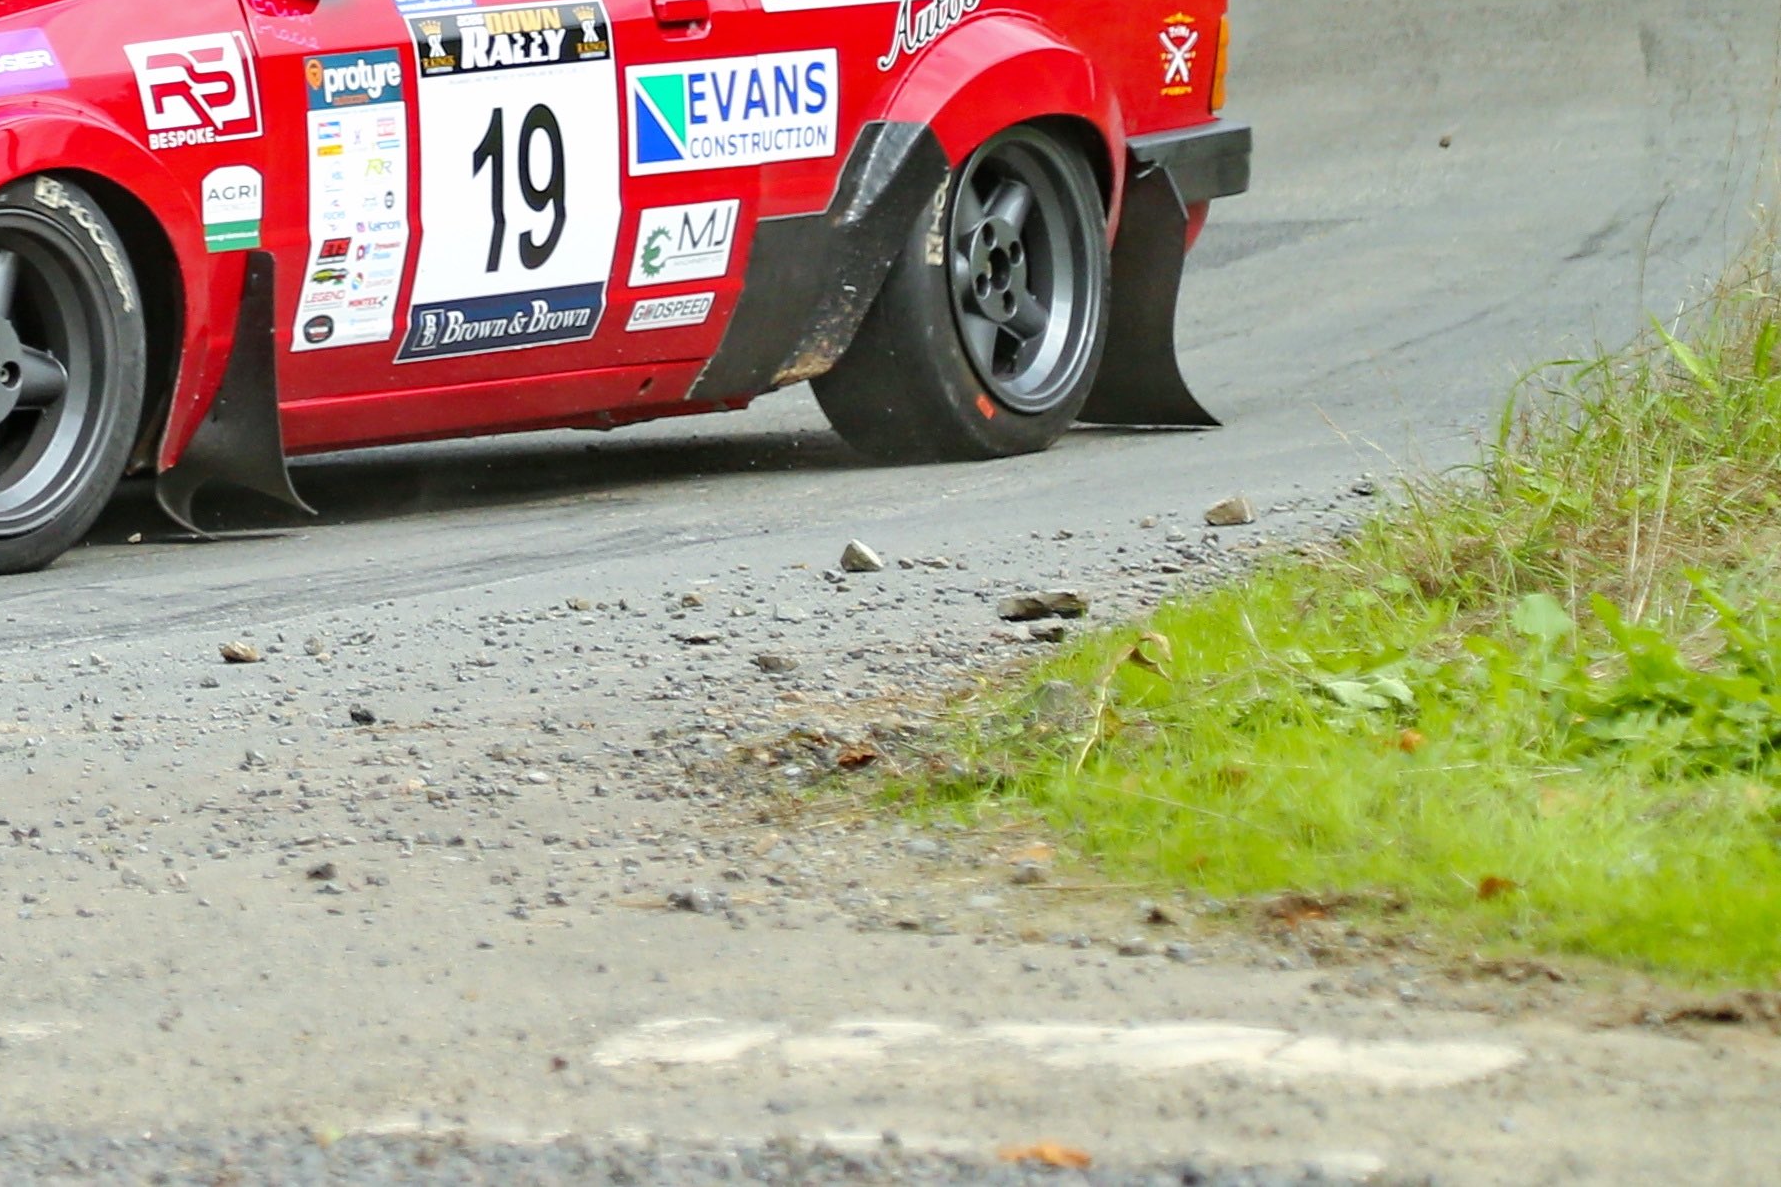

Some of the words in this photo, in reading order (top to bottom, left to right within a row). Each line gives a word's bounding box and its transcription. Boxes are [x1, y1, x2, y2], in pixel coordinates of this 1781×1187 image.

[483, 8, 561, 35] DOWN
[460, 25, 566, 70] RALLY
[323, 59, 401, 103] protyre
[688, 61, 828, 125] EVANS
[148, 126, 215, 150] BESPOKE
[690, 125, 828, 159] CONSTRUCTION
[206, 184, 257, 201] AGRI
[472, 103, 566, 273] 19
[678, 206, 732, 251] MJ
[441, 311, 507, 344] Brown
[507, 312, 528, 335] &
[526, 299, 591, 334] Brown
